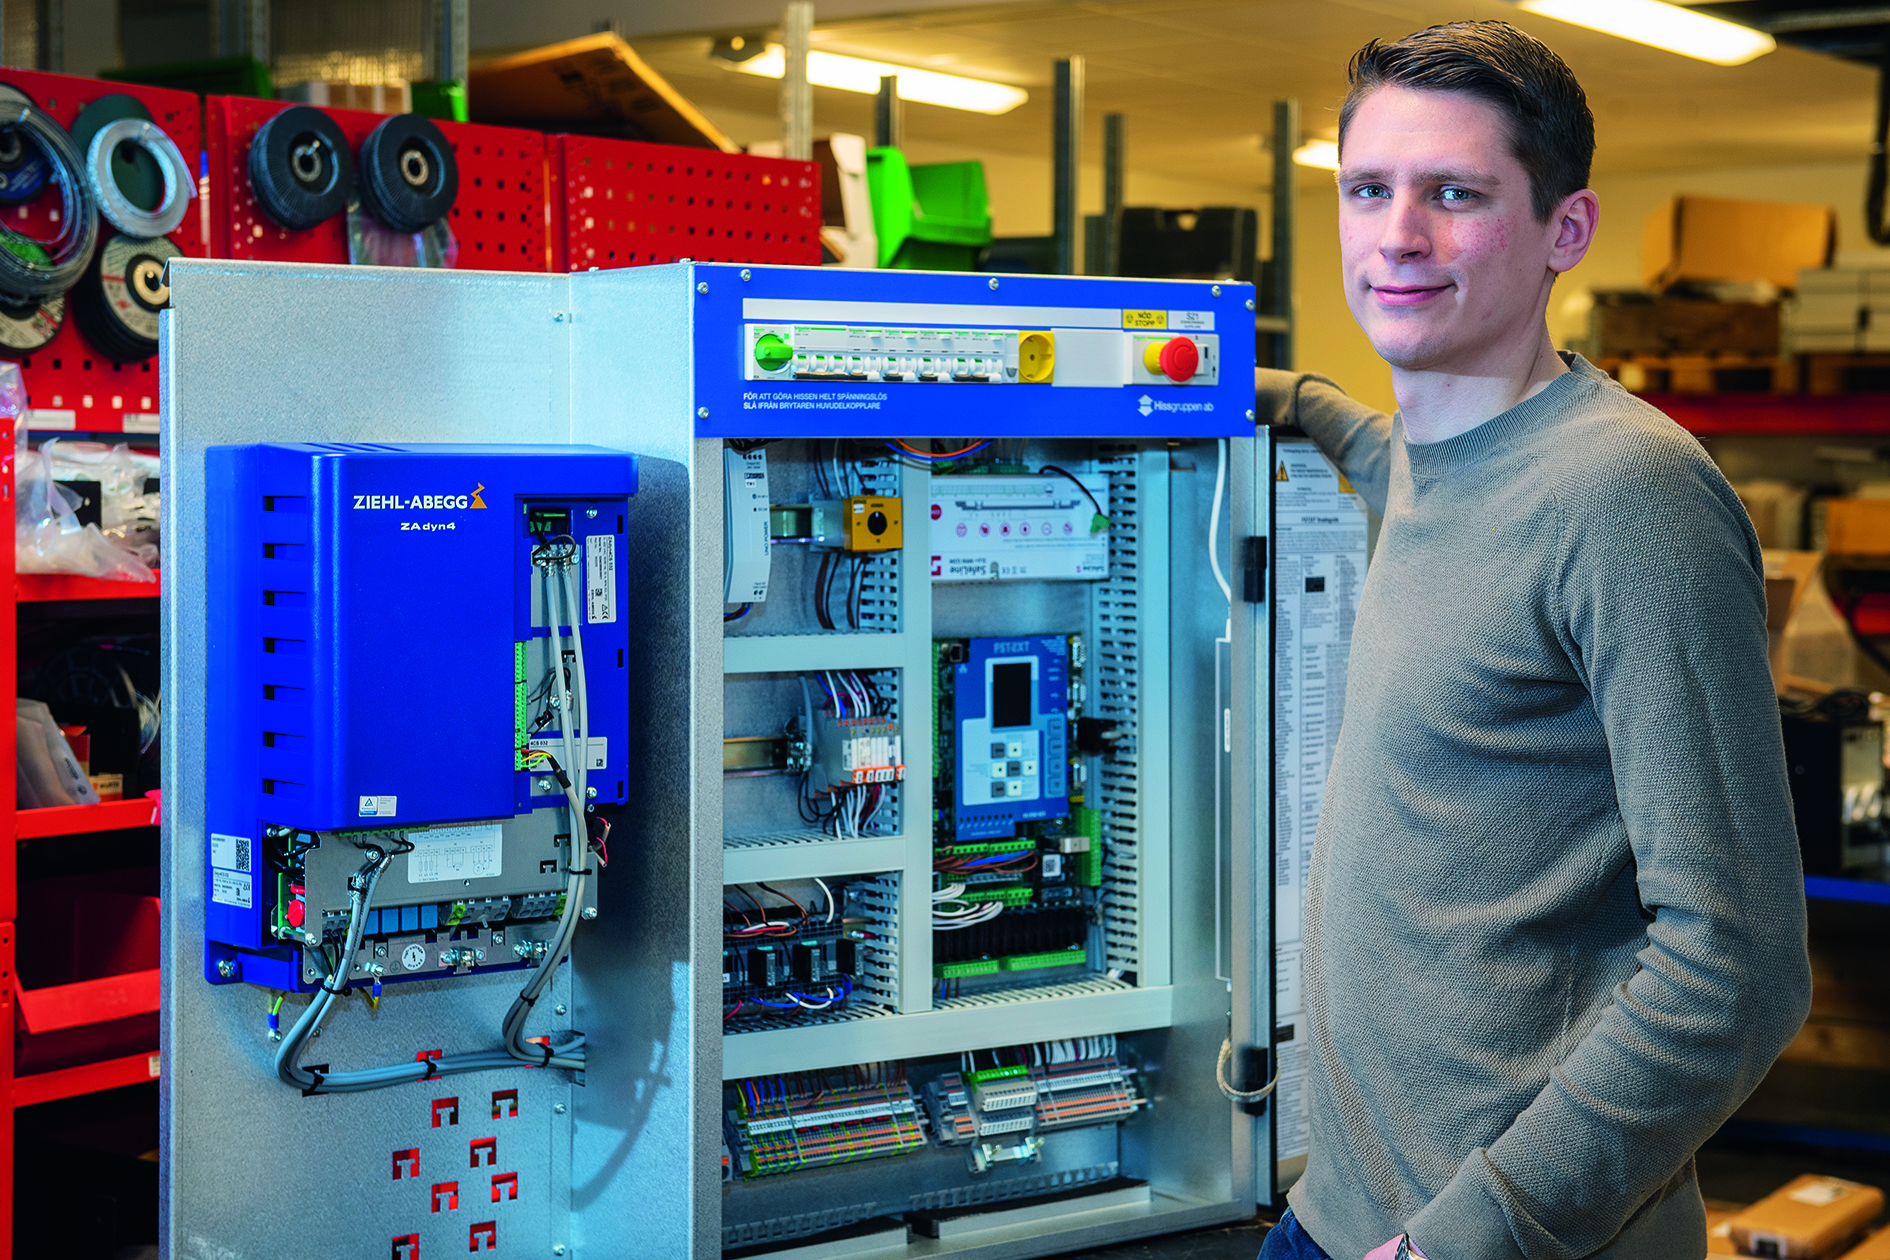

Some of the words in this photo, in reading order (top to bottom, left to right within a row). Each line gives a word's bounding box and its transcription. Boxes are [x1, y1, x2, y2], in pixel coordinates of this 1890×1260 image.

[1134, 319, 1155, 327] STOPP
[743, 391, 758, 400] FÖR
[759, 392, 772, 400] ATT
[772, 391, 793, 400] GÖRA
[793, 392, 818, 400] HISSEN
[819, 392, 836, 400] HELT
[836, 391, 888, 401] SPÄNNINGSLÖS
[743, 401, 757, 410] SLÅ
[758, 401, 779, 410] IFRÅN
[779, 402, 815, 410] BRYTAREN
[816, 401, 881, 410] HUVUDELKOPPLARE
[1153, 400, 1203, 413] Hissgruppen
[1203, 401, 1215, 412] ab
[353, 495, 468, 510] ZIEHL-ABEGG
